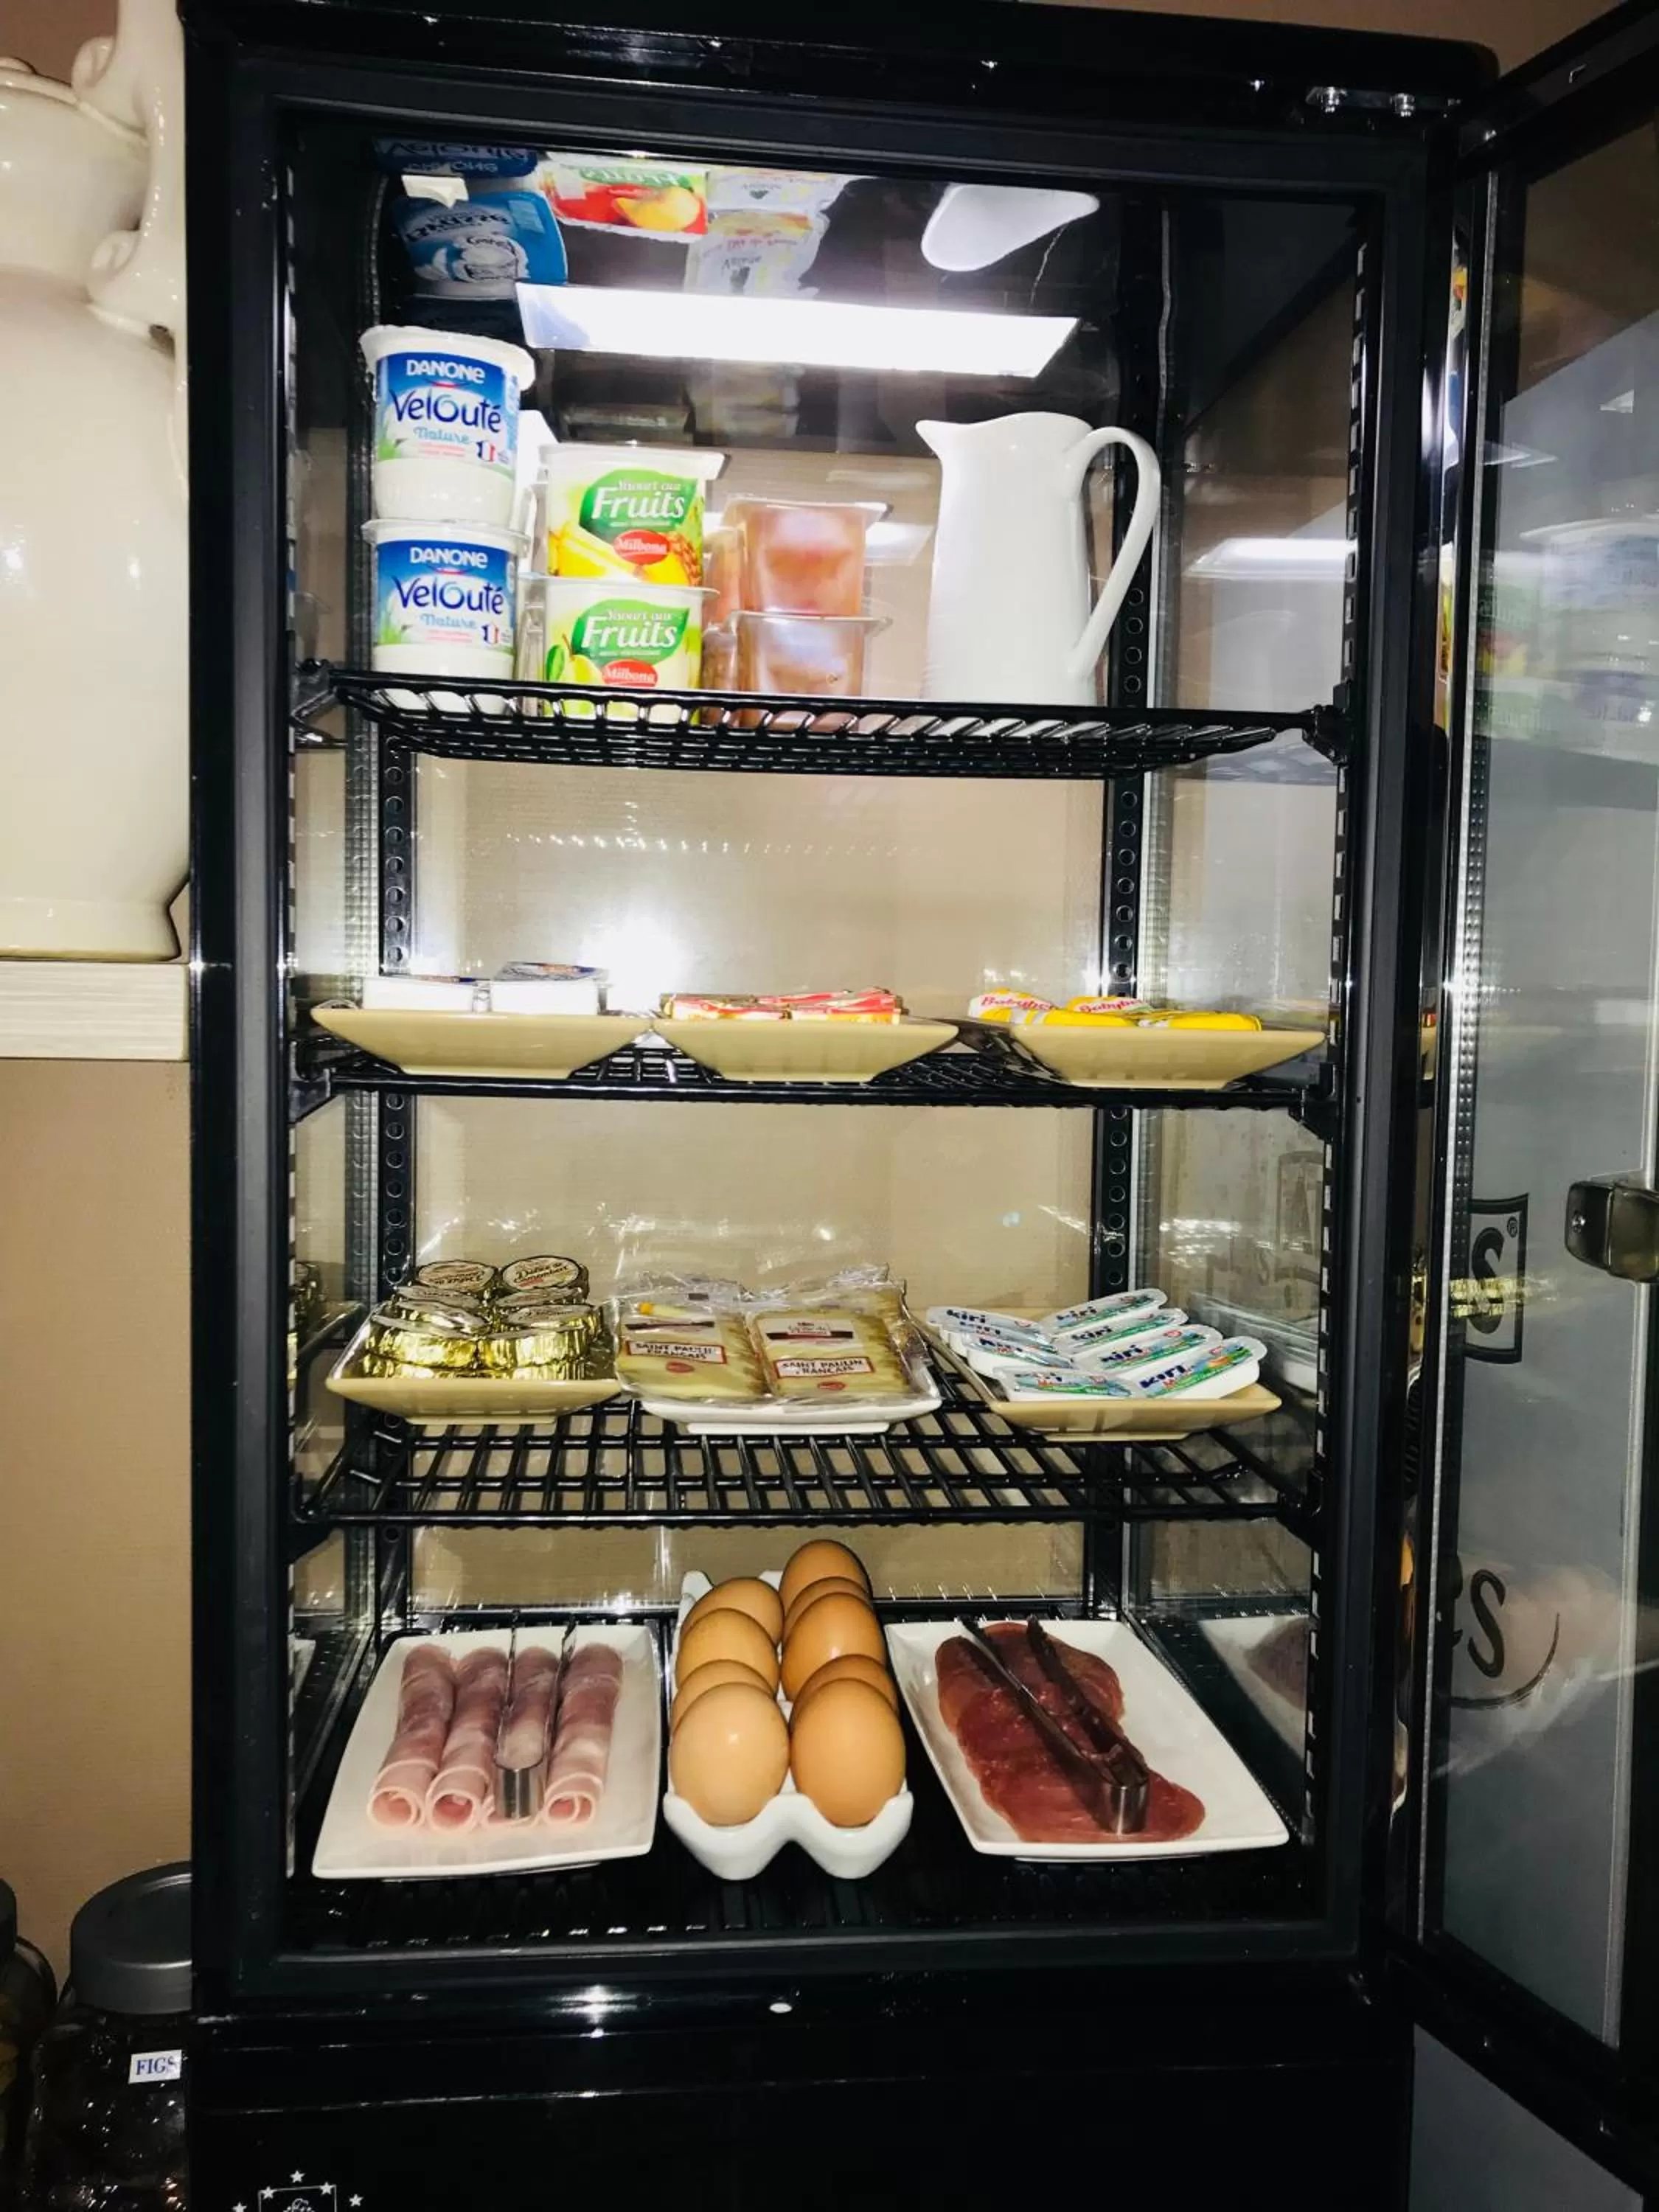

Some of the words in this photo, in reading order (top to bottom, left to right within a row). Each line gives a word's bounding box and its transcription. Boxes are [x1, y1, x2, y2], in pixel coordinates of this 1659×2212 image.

[591, 486, 685, 520] Fruits
[580, 615, 677, 649] Fruits
[136, 2056, 175, 2076] FIGS
